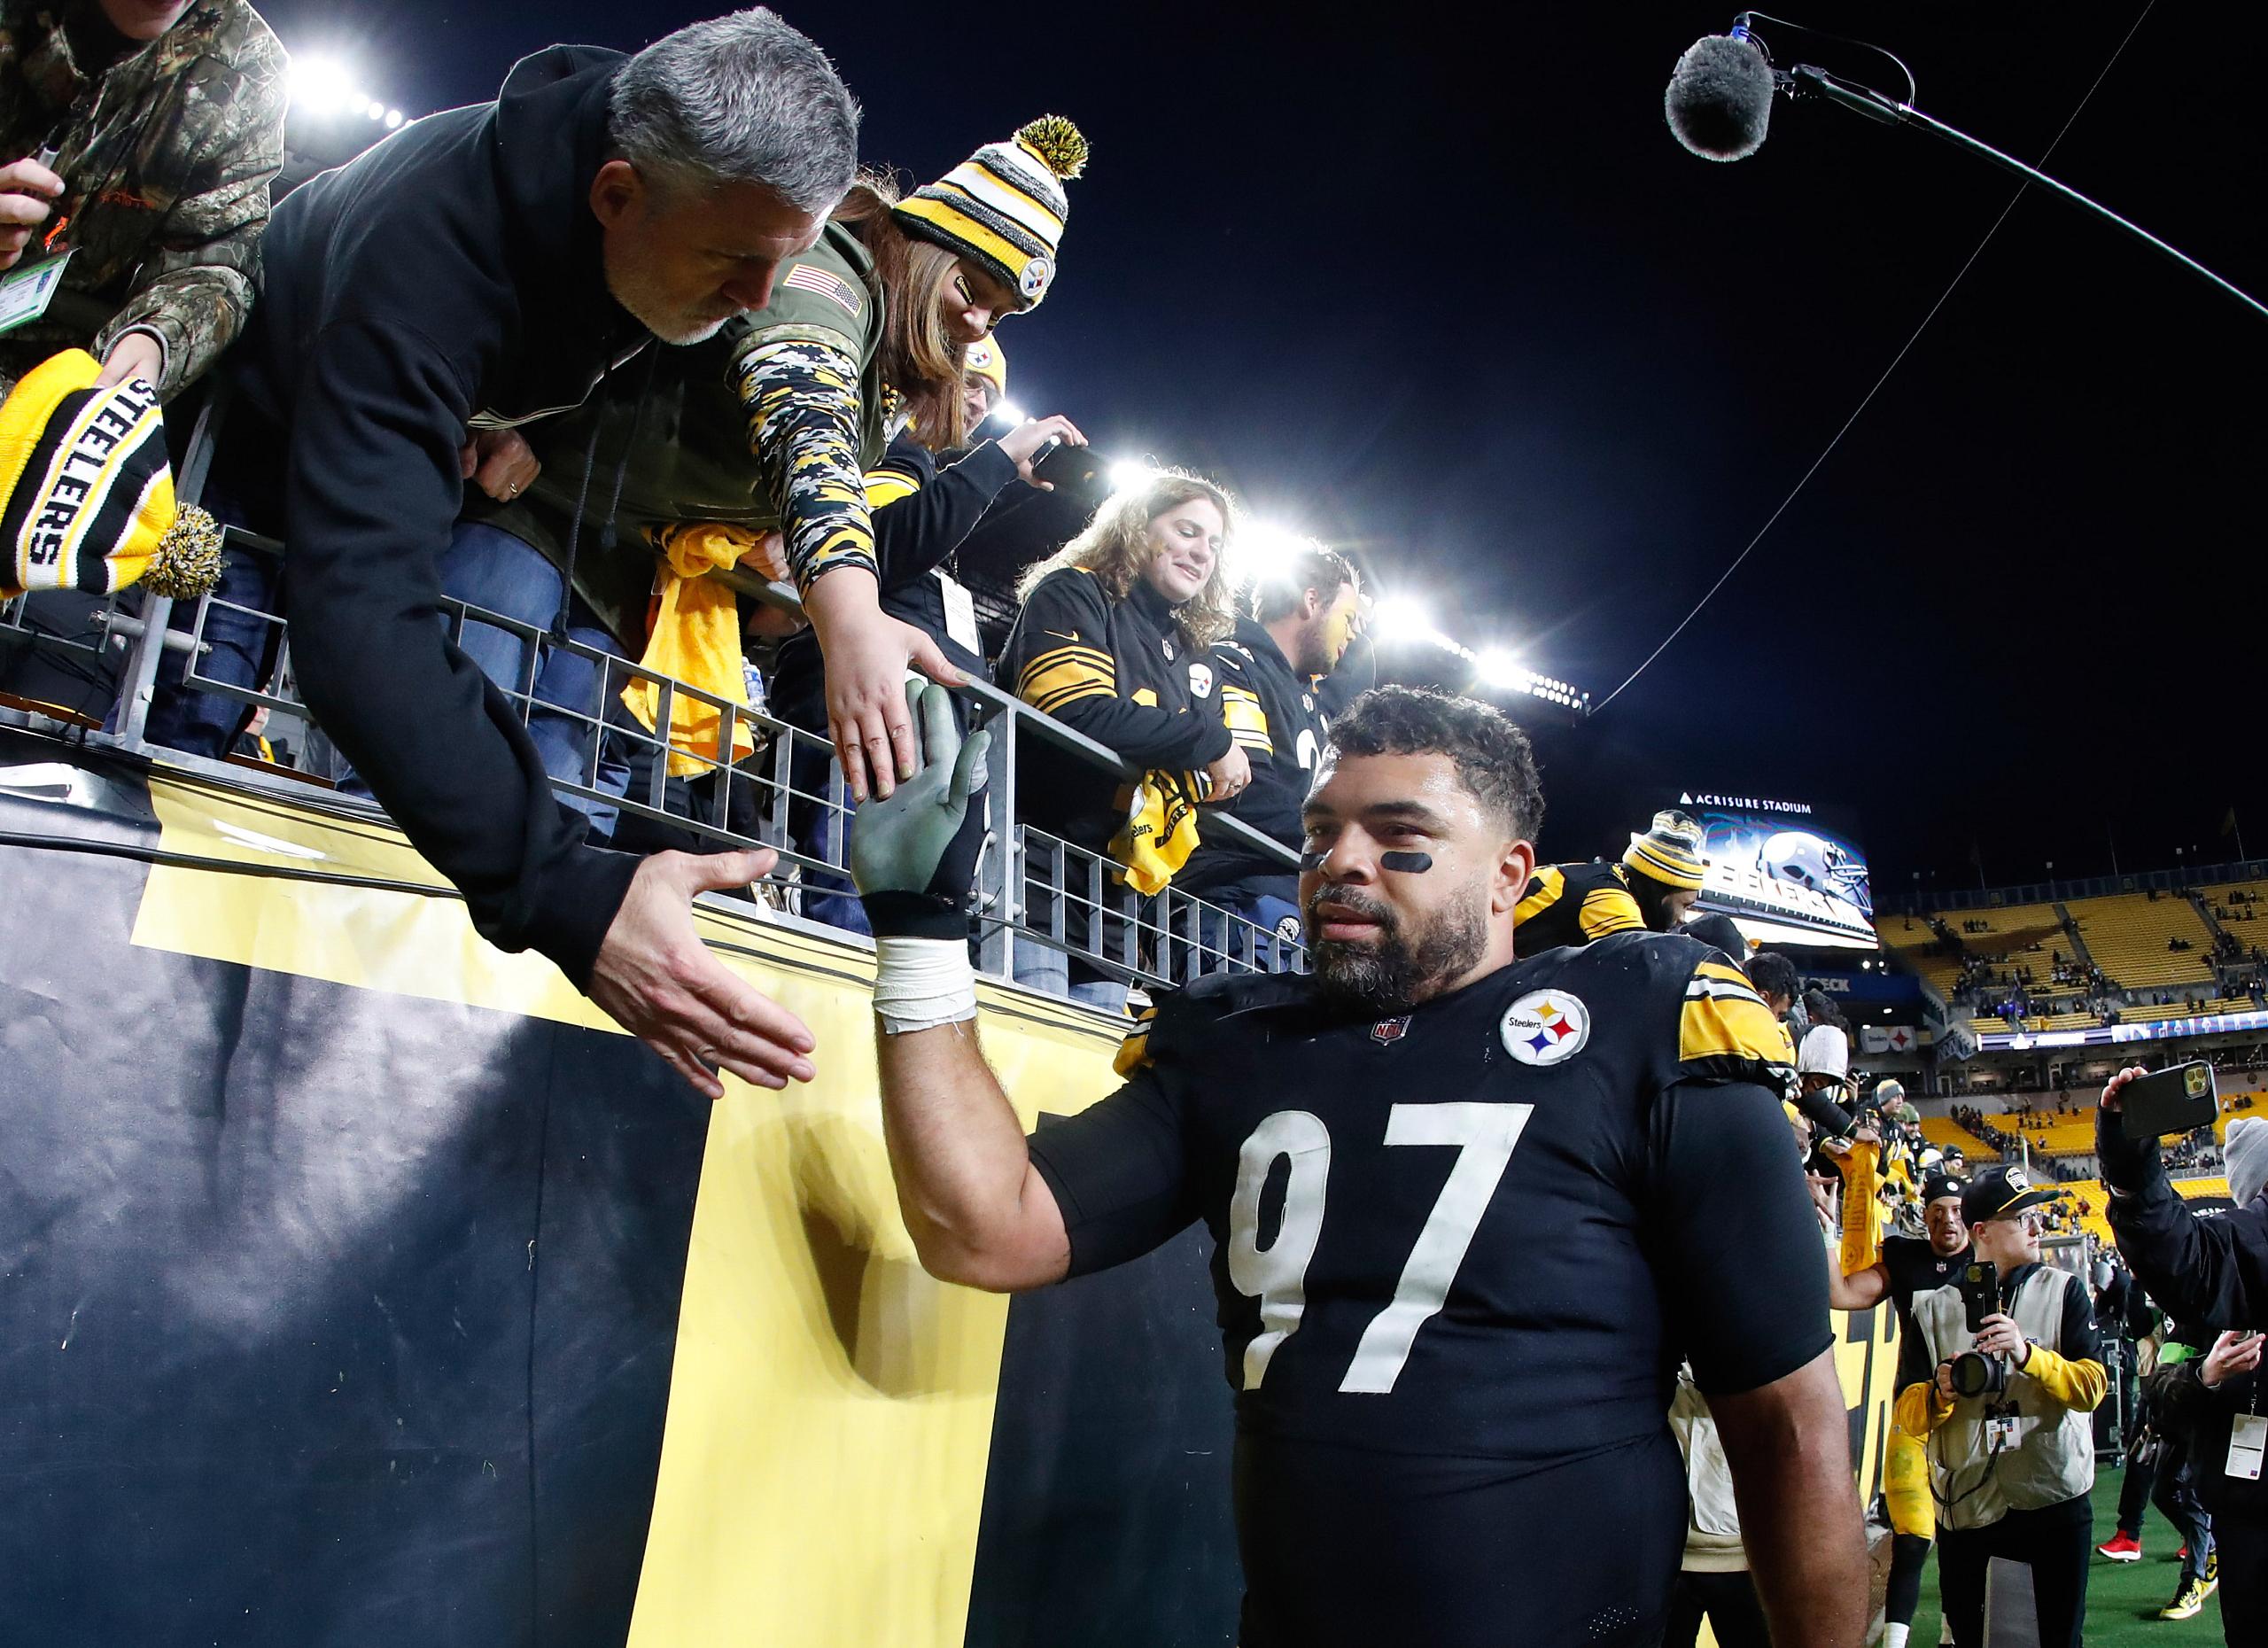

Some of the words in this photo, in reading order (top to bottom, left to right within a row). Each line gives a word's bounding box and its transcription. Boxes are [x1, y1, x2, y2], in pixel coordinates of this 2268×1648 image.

[29, 378, 160, 565] STEELERS
[1696, 794, 1759, 809] ACRISURE
[1762, 800, 1812, 814] STADIUM
[1508, 1017, 1542, 1029] Steelers
[1228, 1101, 1535, 1394] 97
